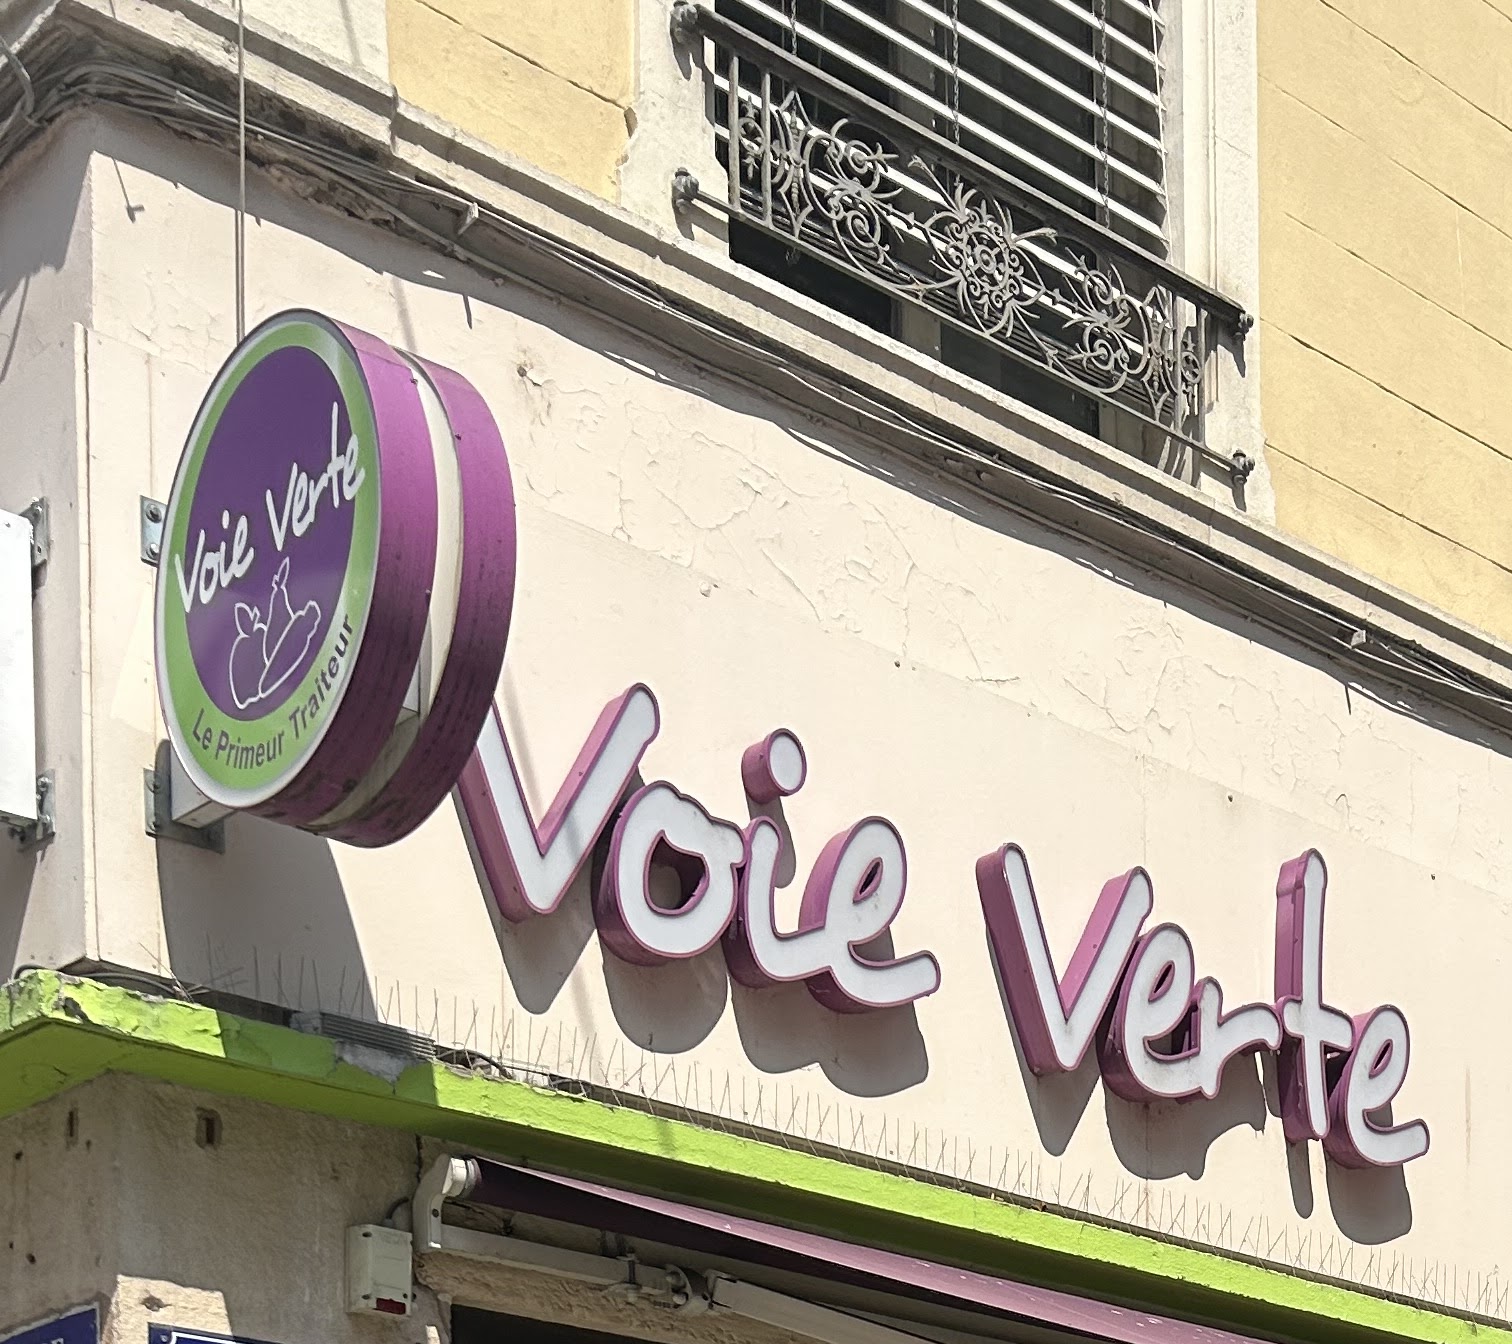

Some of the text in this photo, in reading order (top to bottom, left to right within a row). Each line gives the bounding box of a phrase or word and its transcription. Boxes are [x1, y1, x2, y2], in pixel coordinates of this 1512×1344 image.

[175, 402, 365, 614] Voie Verte
[192, 613, 354, 770] Le Primeur Traiteur
[455, 682, 1430, 1168] Voie Verte
